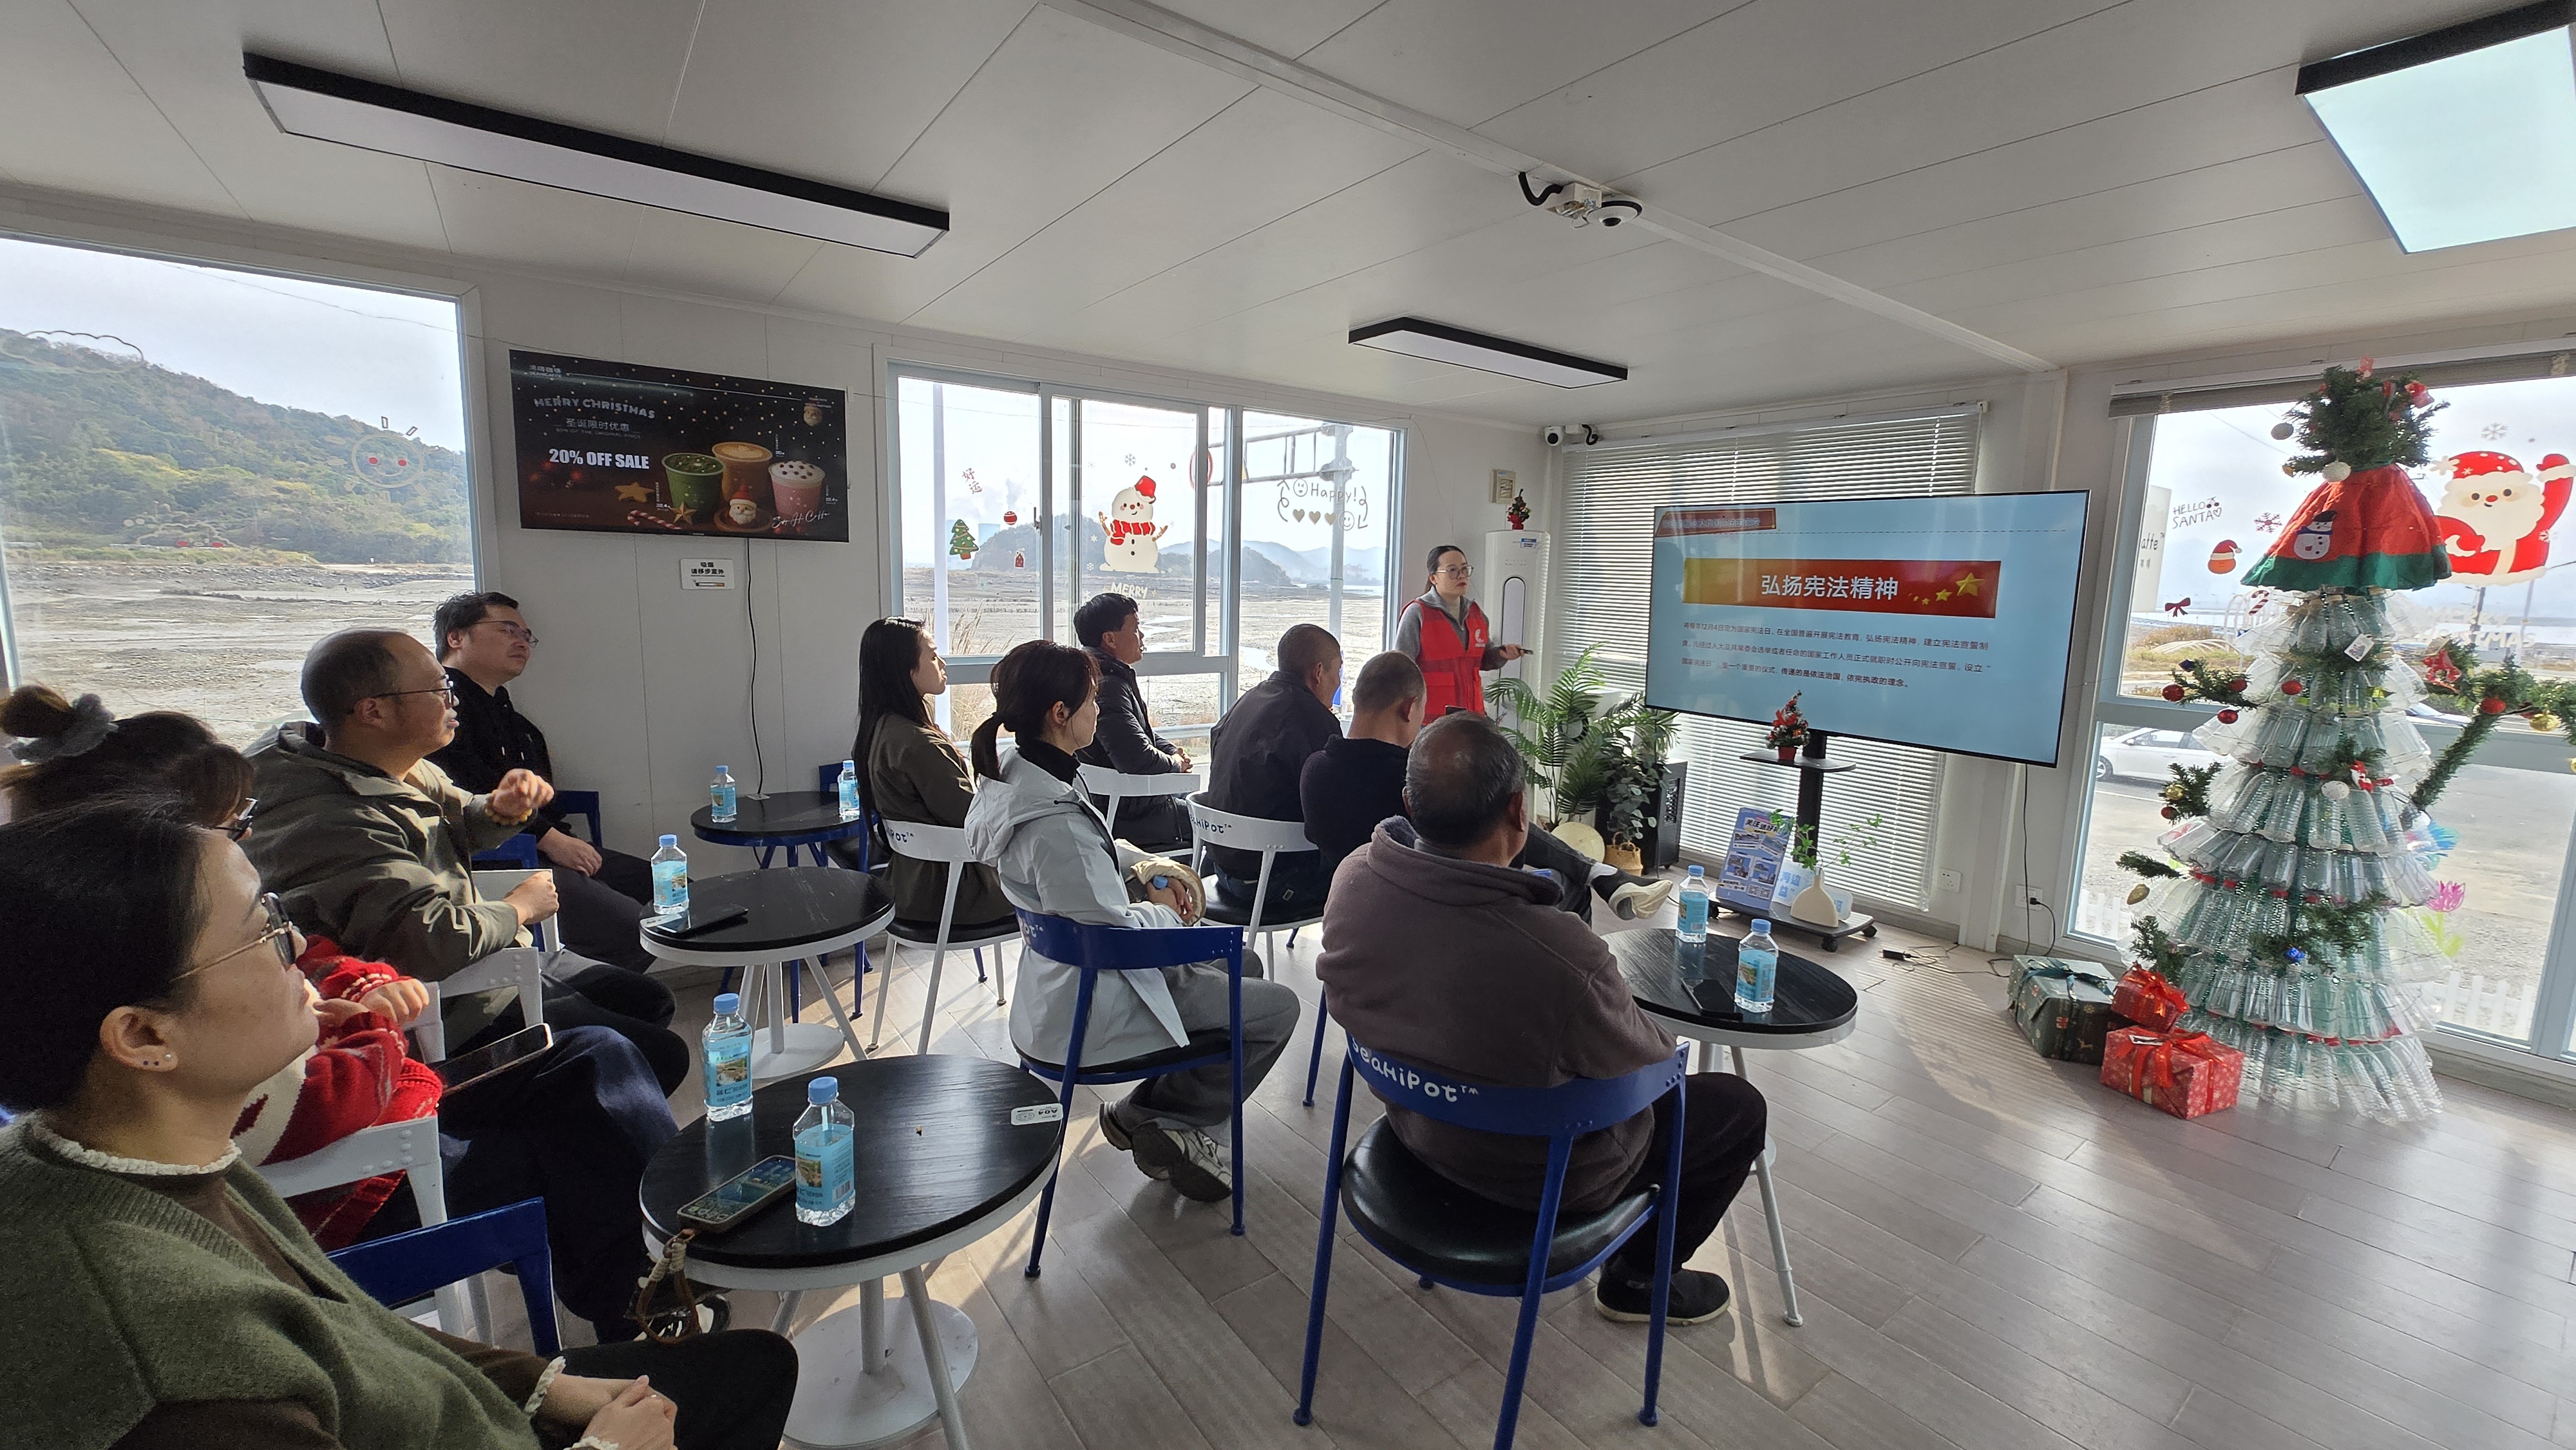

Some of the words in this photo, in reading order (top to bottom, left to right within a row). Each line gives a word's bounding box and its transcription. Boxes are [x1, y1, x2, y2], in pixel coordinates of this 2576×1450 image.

[533, 397, 579, 407] MERRY
[582, 399, 656, 419] CHRISTMAS
[565, 418, 630, 431] 圣诞限时优惠
[549, 448, 583, 464] 20%
[587, 451, 612, 466] OFF
[615, 453, 649, 469] SALE
[961, 467, 983, 494] 好运
[1311, 482, 1357, 504] Happy!
[2172, 501, 2206, 515] HELLO
[2172, 510, 2214, 529] SANTA
[1110, 582, 1148, 599] MERRY
[1761, 575, 1899, 600] 弘扬宪法精神
